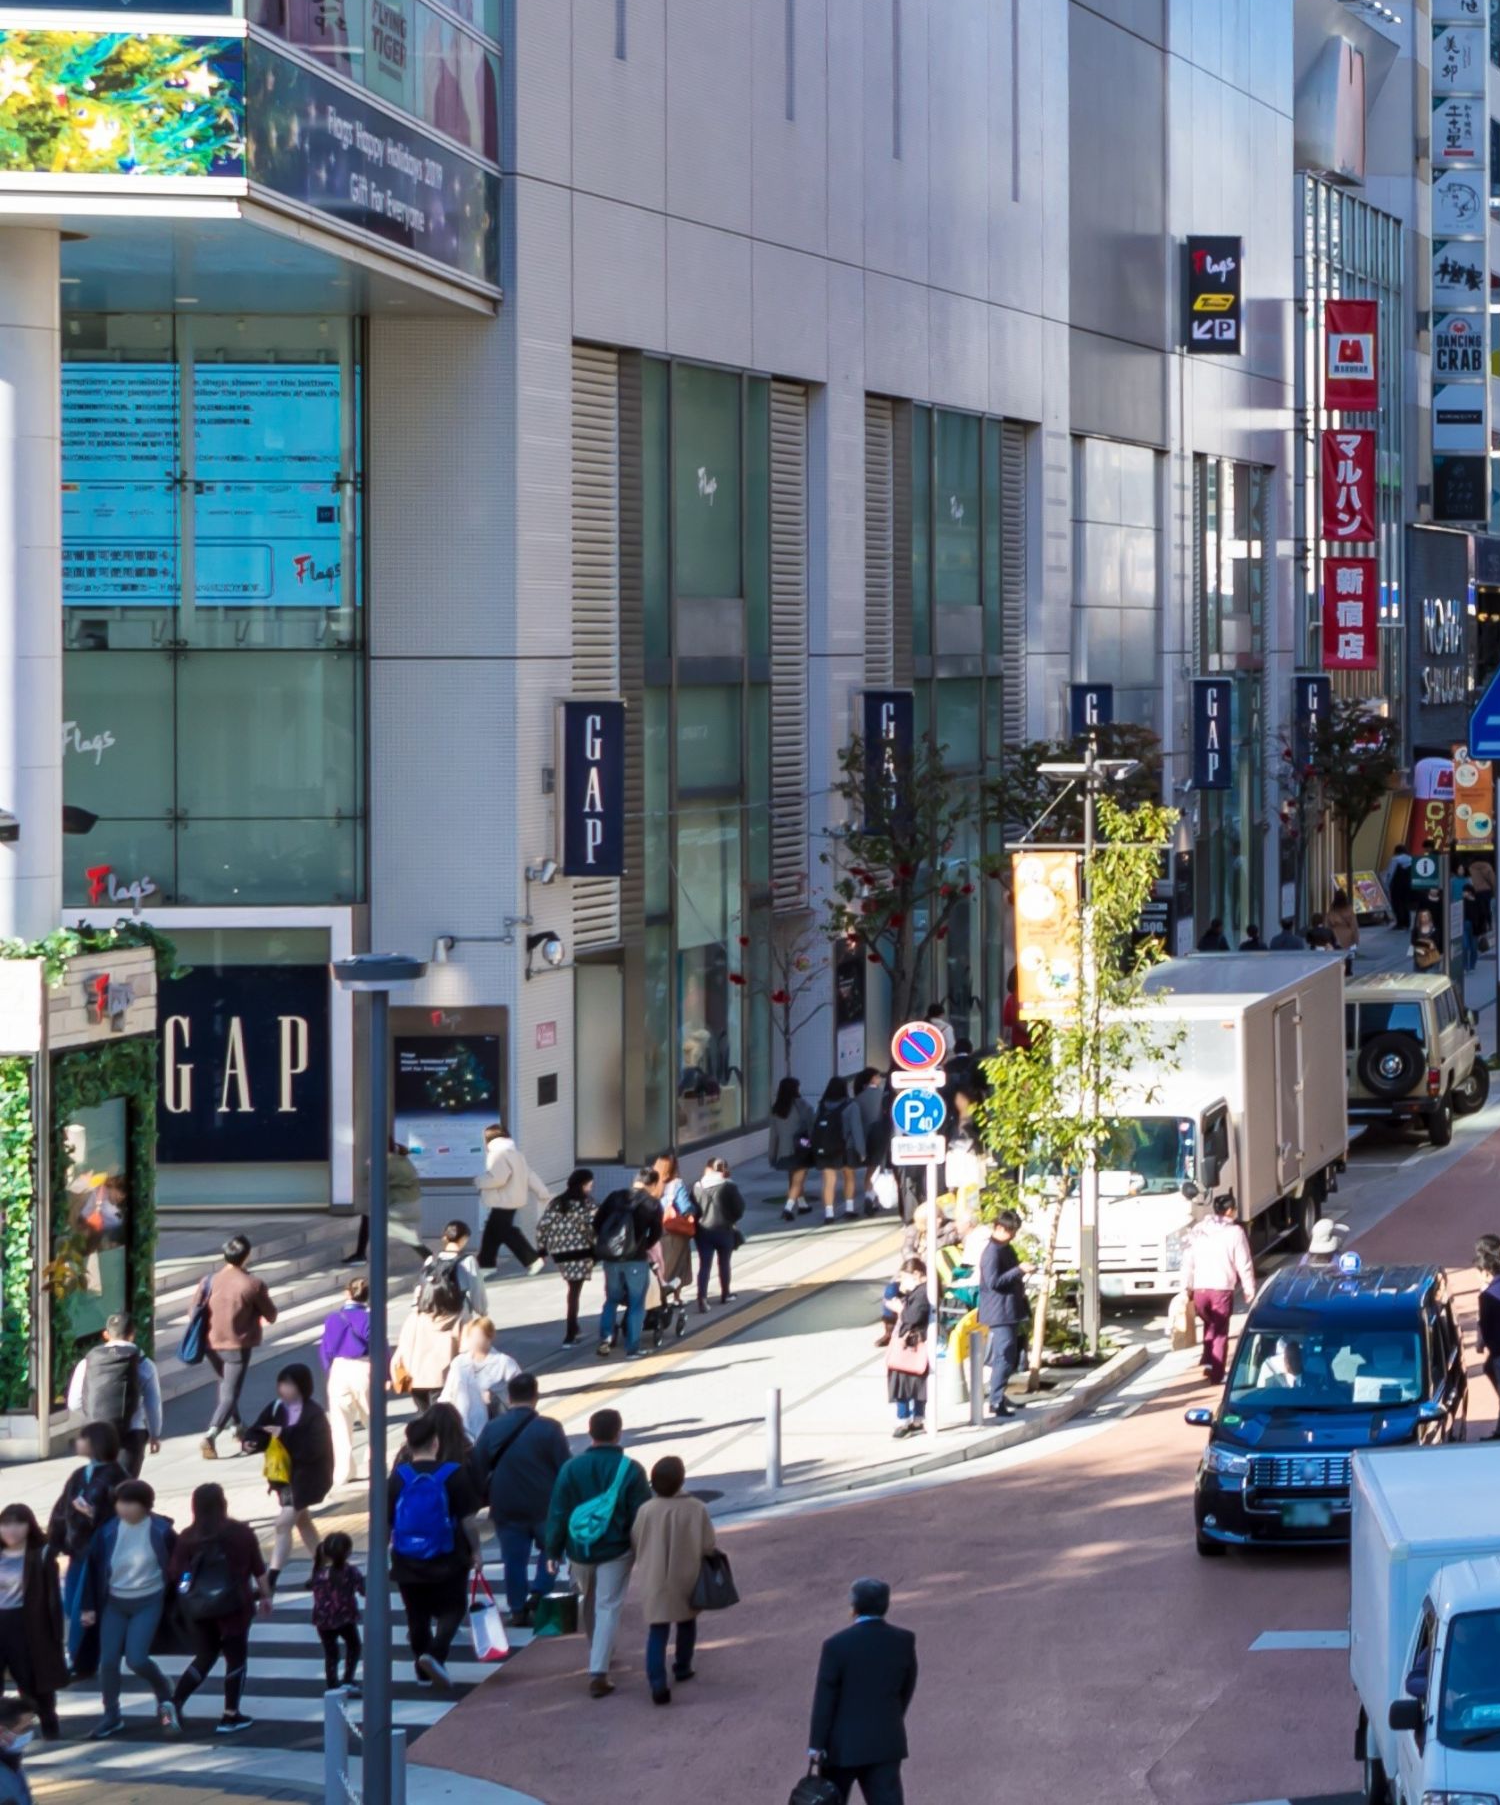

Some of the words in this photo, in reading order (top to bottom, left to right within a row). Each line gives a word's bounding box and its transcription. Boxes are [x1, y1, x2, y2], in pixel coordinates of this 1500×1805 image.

[371, 26, 407, 69] TIGER
[327, 105, 354, 150] Flags
[356, 120, 384, 168] Happy
[386, 138, 423, 184] Holidays
[350, 173, 368, 205] Gift
[370, 181, 384, 213] For
[386, 191, 425, 233] Everyone
[1193, 249, 1236, 283] Flags
[1220, 323, 1231, 337] P
[1437, 335, 1481, 348] DANCING
[1437, 349, 1481, 372] CRAB
[1336, 434, 1363, 537] マルハン
[1336, 567, 1364, 660] 新宿店
[1207, 687, 1221, 782] GAP
[584, 714, 603, 866] GAP
[85, 865, 156, 915] Flags
[163, 1016, 309, 1114] GAP
[905, 1101, 925, 1131] P
